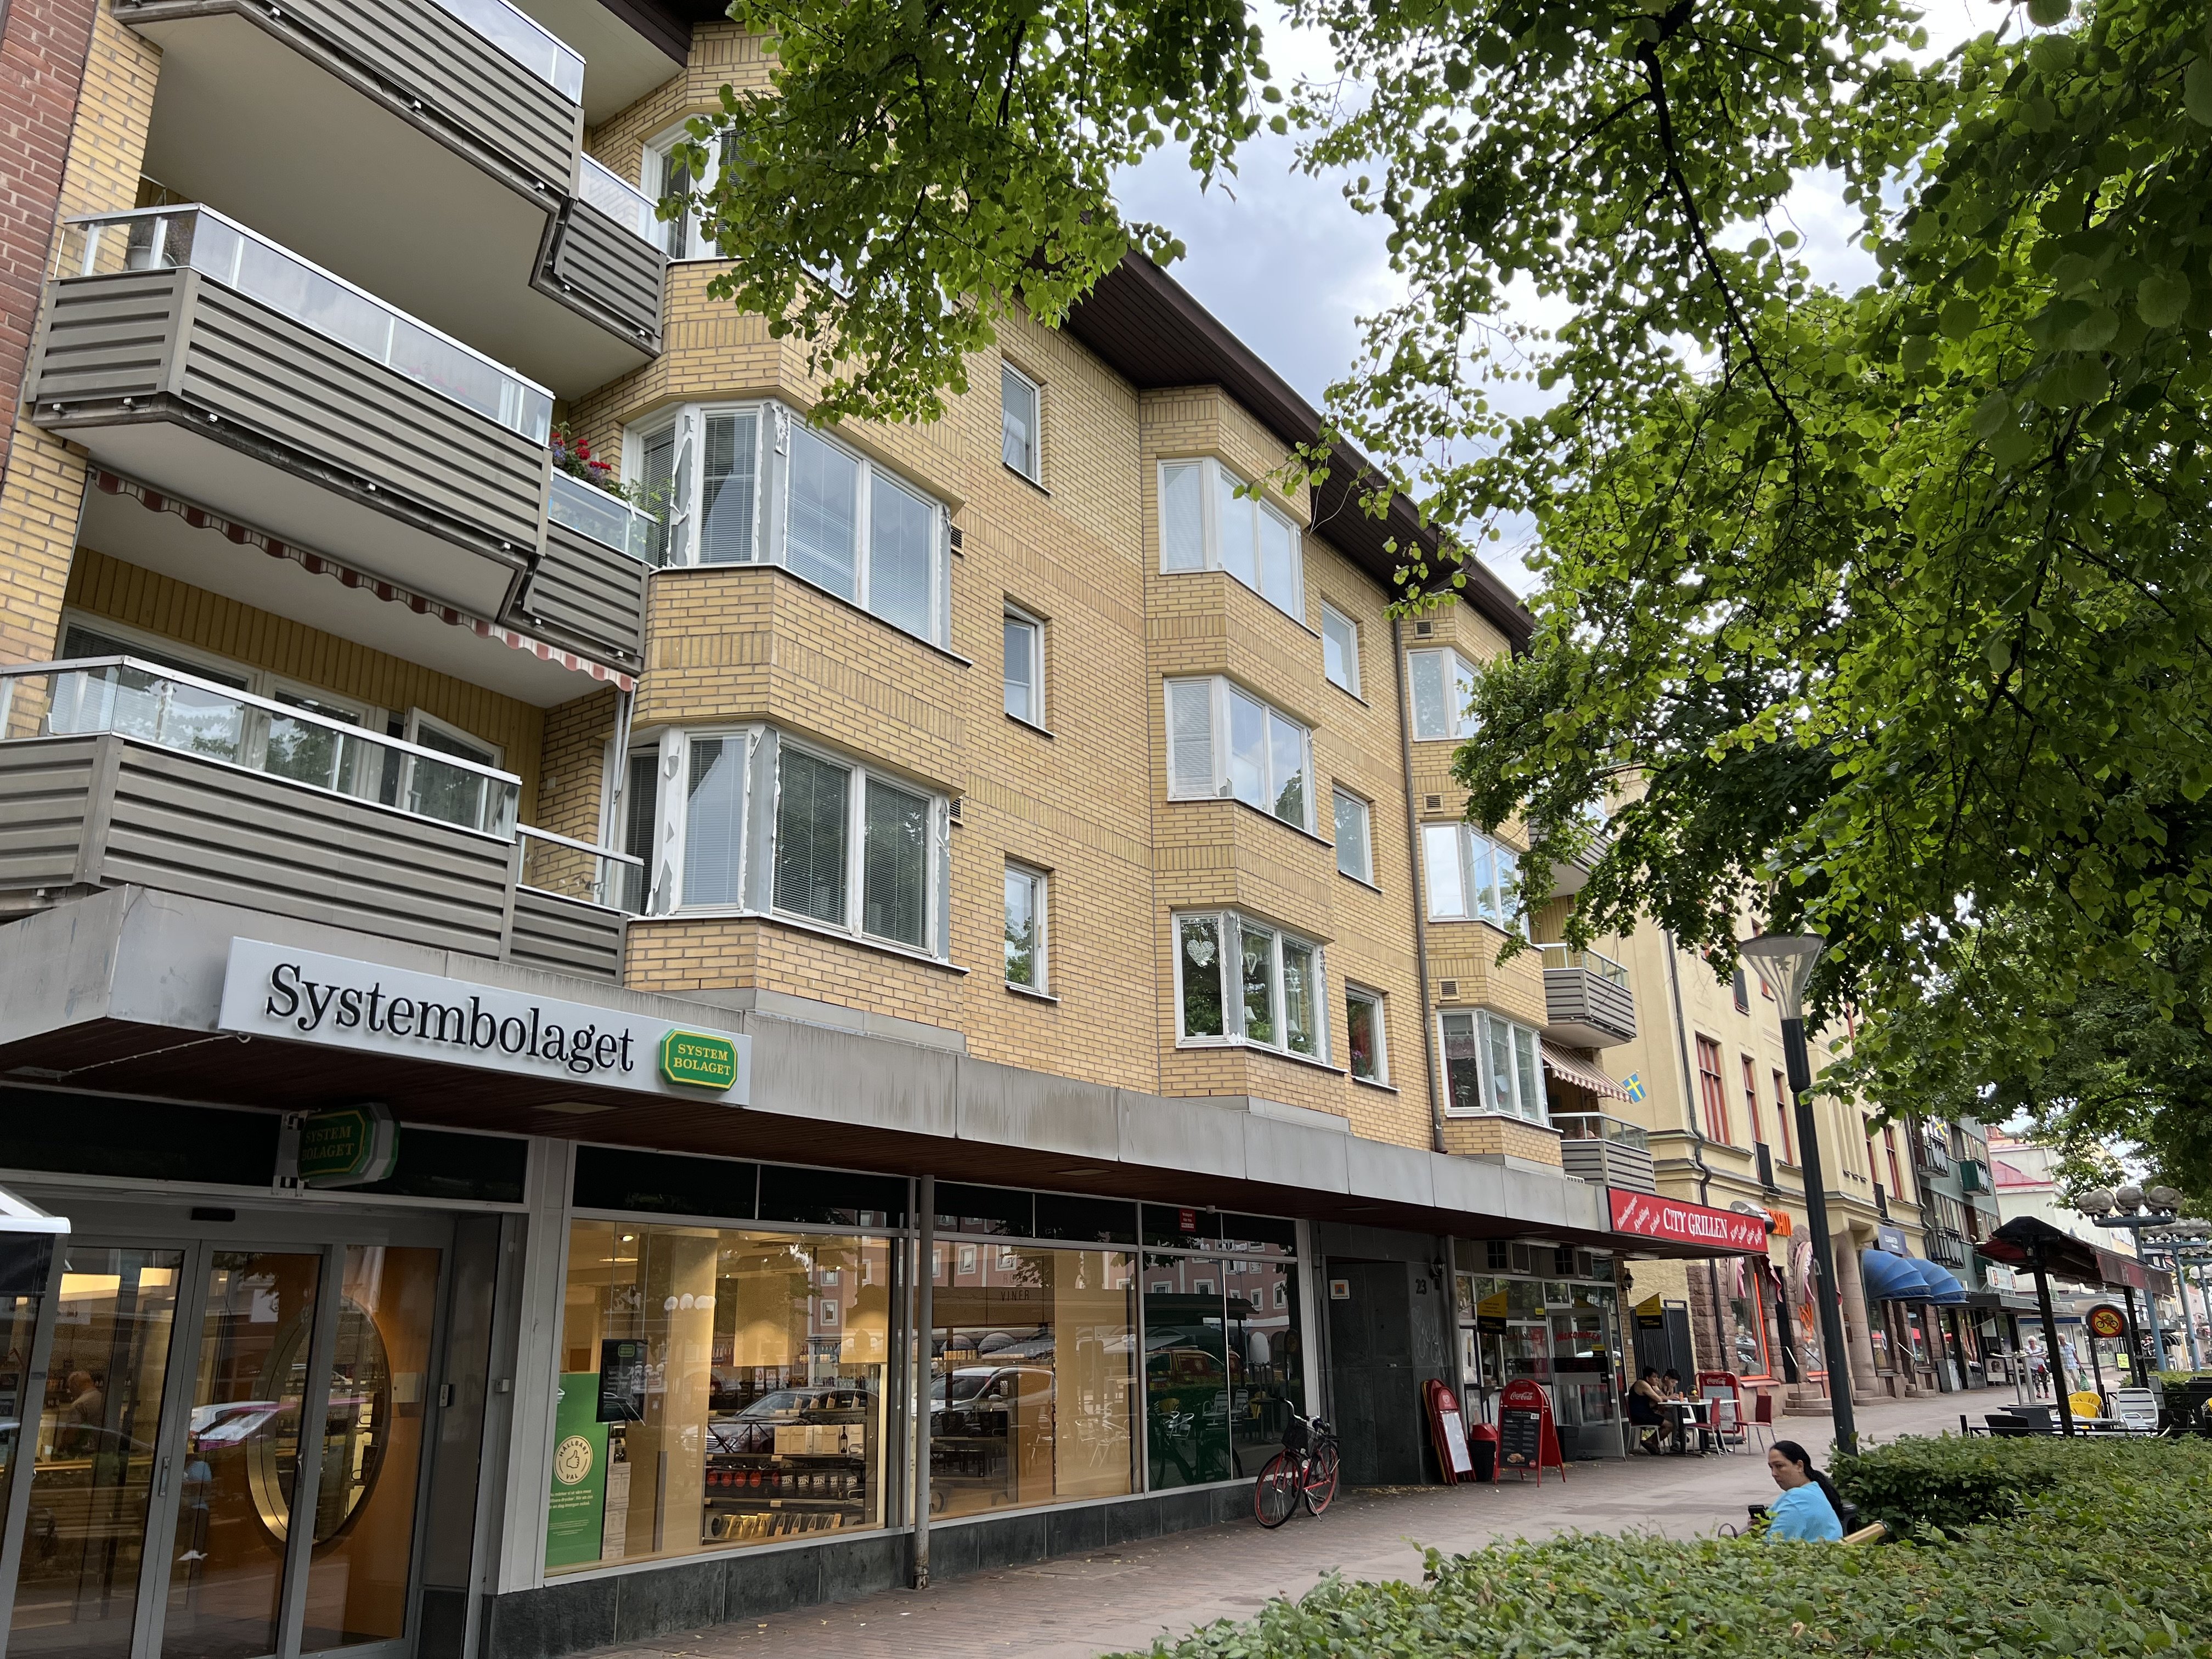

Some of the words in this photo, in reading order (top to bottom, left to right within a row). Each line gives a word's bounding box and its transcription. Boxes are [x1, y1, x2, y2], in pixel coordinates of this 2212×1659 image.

[266, 963, 634, 1074] Systembolaget
[678, 1043, 728, 1061] SYSTEM
[673, 1057, 731, 1076] BOLAGET
[306, 1125, 353, 1143] SYSTEM
[302, 1143, 354, 1160] BOLAGET
[1663, 1207, 1686, 1233] CITY
[1688, 1212, 1728, 1239] GRILLEN
[1415, 1278, 1427, 1295] 23
[1001, 1290, 1029, 1302] VINER
